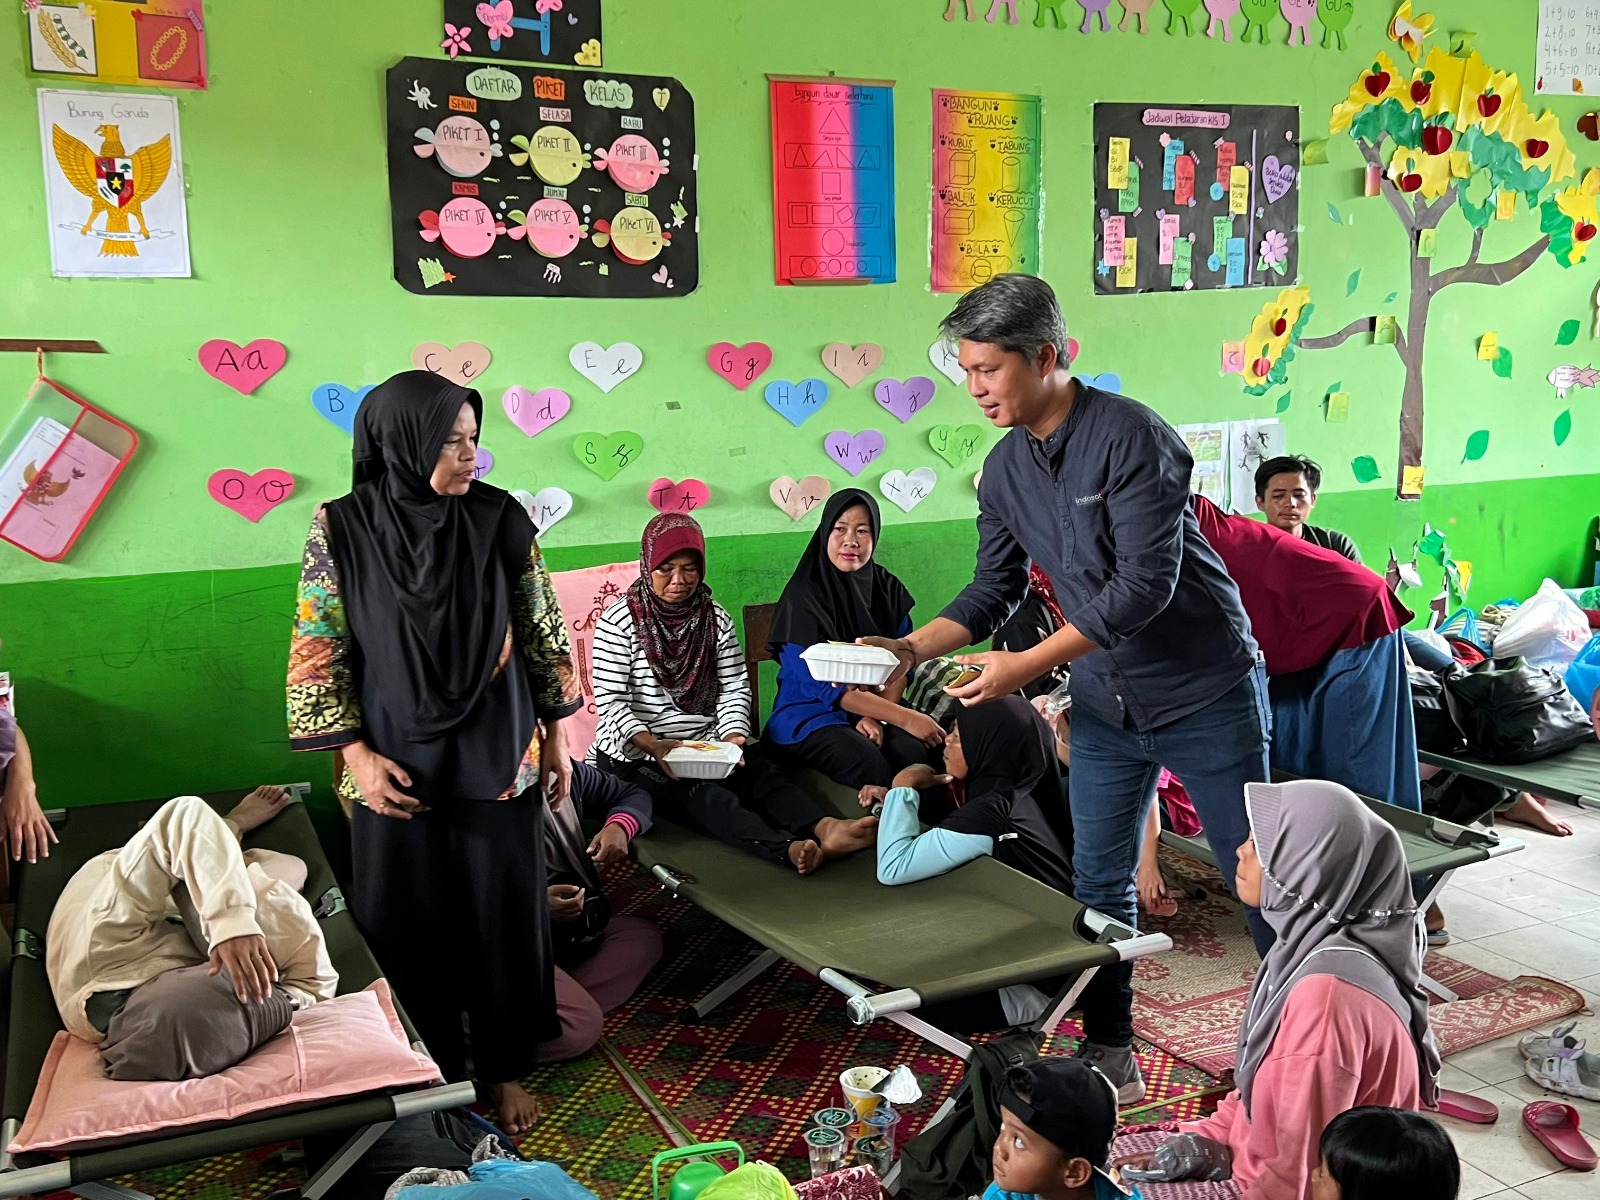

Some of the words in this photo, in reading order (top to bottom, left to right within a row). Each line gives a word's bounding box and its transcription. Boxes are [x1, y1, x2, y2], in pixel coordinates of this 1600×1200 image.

[473, 75, 517, 93] DAFTAR
[534, 78, 565, 97] PIKET
[589, 85, 625, 102] KELAS
[657, 91, 667, 107] I
[794, 84, 820, 101] bangun
[111, 102, 150, 119] Garuda
[451, 98, 475, 110] SENIN
[949, 97, 993, 112] BANGUN
[541, 108, 571, 120] SELASA
[974, 113, 1011, 127] RUANG
[1145, 111, 1173, 124] Jadwal
[1175, 112, 1208, 125] Pelajaran
[622, 118, 642, 129] RABU
[442, 124, 471, 141] PIKET
[474, 128, 484, 141] I
[537, 135, 561, 149] PIKET
[563, 138, 572, 152] II
[615, 143, 637, 157] PIKET
[947, 137, 974, 149] KUBUS
[998, 140, 1031, 152] TABUNG
[453, 183, 477, 194] KAMIS
[626, 194, 647, 207] SABTU
[947, 190, 976, 203] BALK
[996, 194, 1035, 206] KERUCUT
[444, 208, 471, 222] PIKET
[475, 208, 486, 225] IV
[534, 208, 561, 222] PIKET
[966, 244, 990, 255] BLA
[327, 388, 345, 413] B
[1075, 492, 1103, 505] indosat
